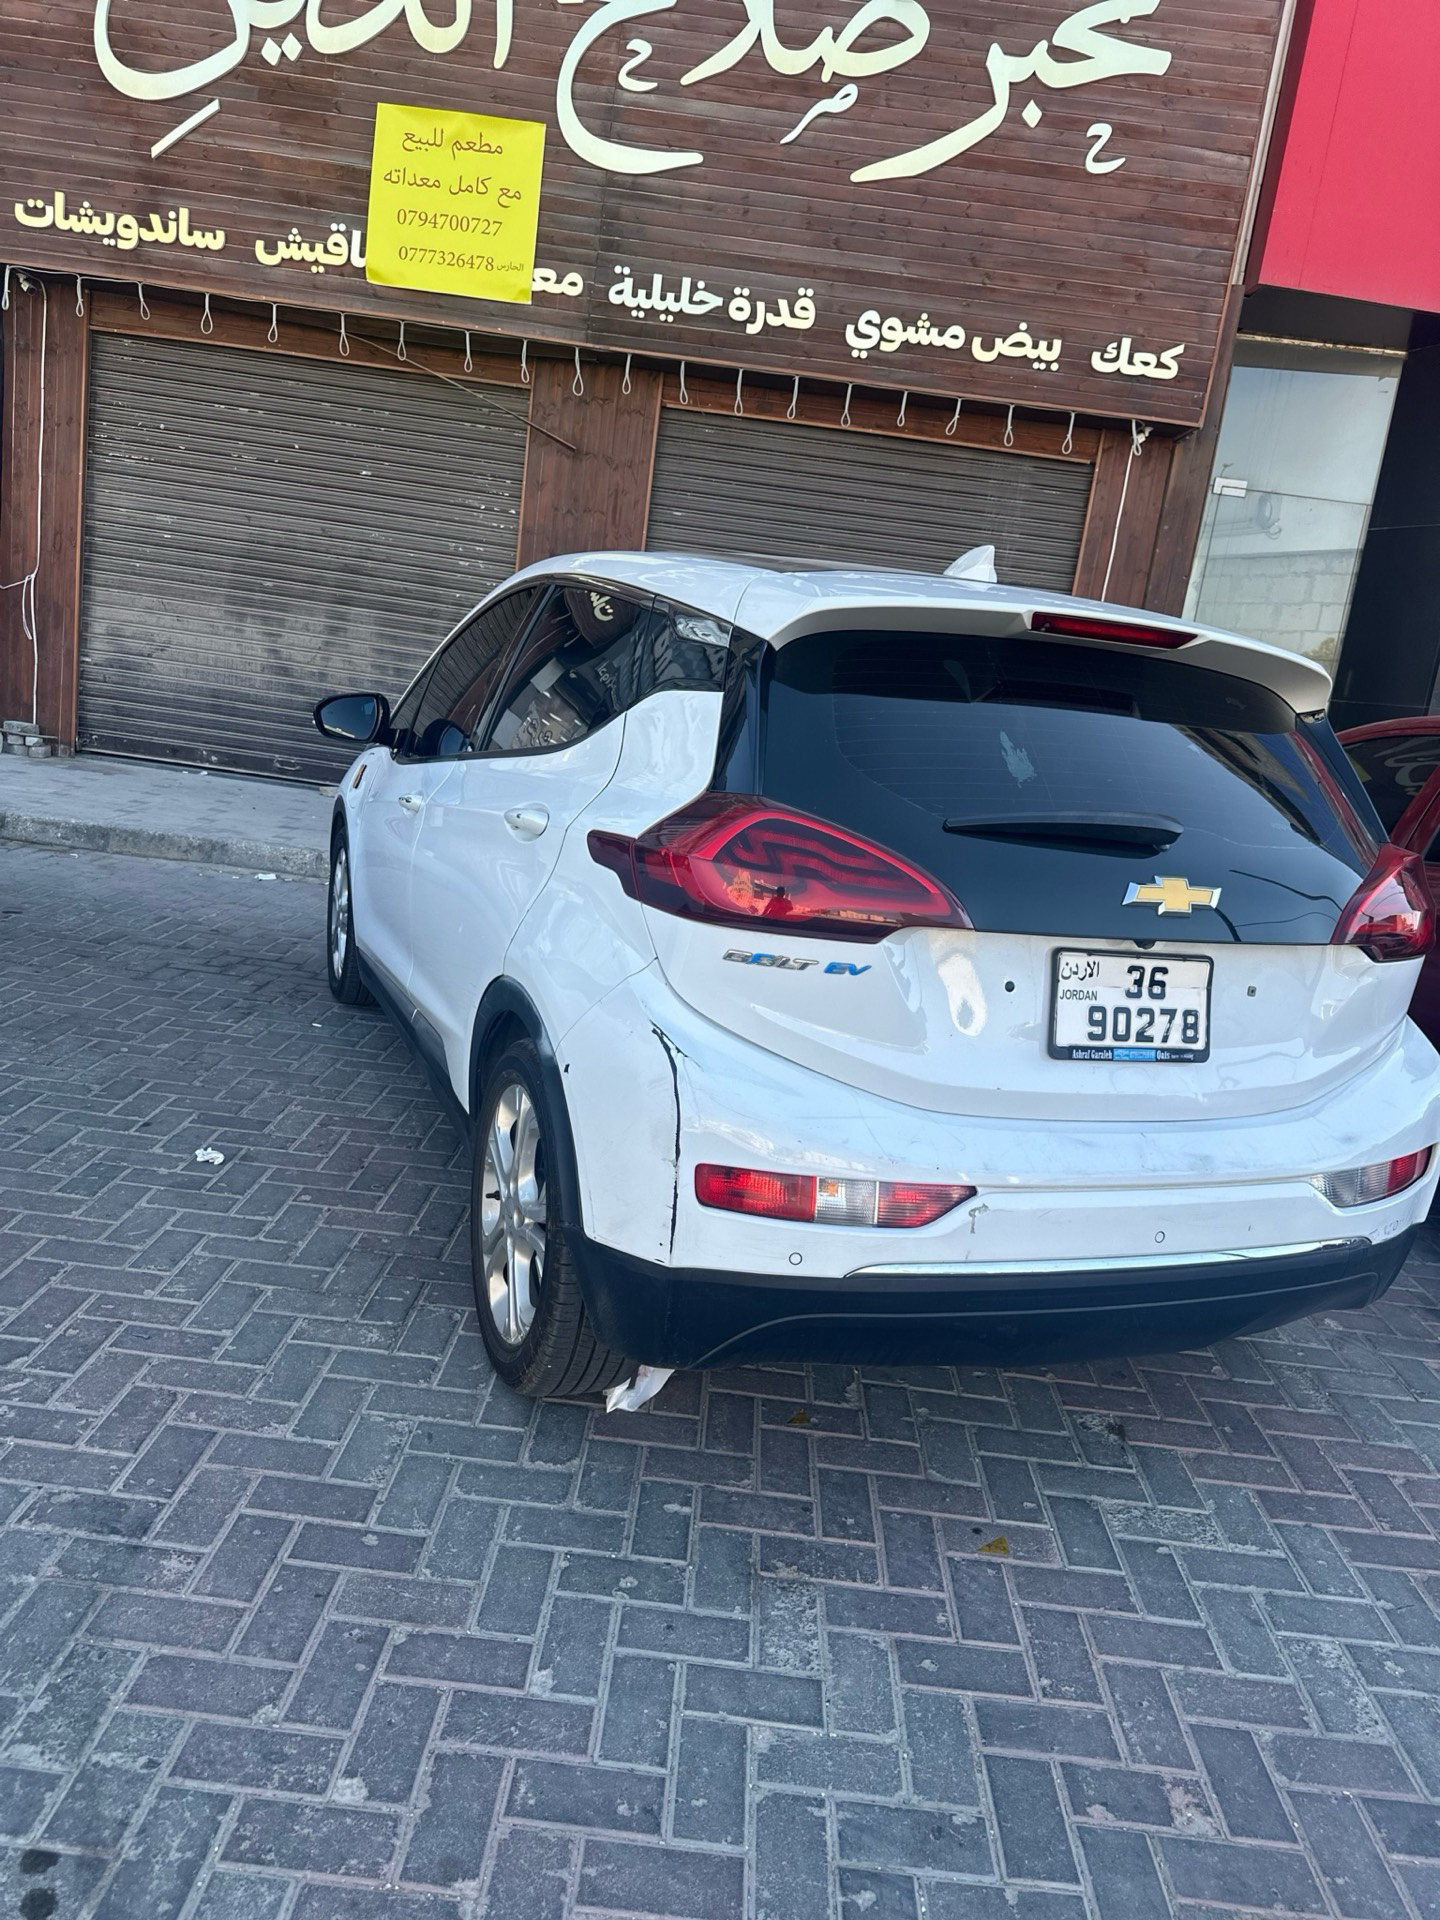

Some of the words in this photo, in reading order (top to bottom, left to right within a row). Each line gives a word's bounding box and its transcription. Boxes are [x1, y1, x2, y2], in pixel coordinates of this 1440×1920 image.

[401, 127, 445, 152] للبيع
[451, 131, 504, 161] مطعم
[383, 167, 441, 189] معداته
[449, 175, 492, 196] كامل
[497, 186, 522, 209] مع
[14, 191, 226, 250] ساندويشات
[396, 208, 503, 237] 0794700727
[398, 245, 495, 272] 0777326478
[496, 261, 525, 272] الحارس
[608, 265, 724, 322] خليلية
[728, 286, 816, 335] قدرة
[845, 310, 966, 359] مشوي
[971, 321, 1063, 371] بيض
[1090, 337, 1185, 380] كعك
[823, 961, 873, 976] EV
[1125, 965, 1169, 1000] 36
[1059, 988, 1098, 1001] JORDAN
[1087, 1005, 1200, 1044] 90278
